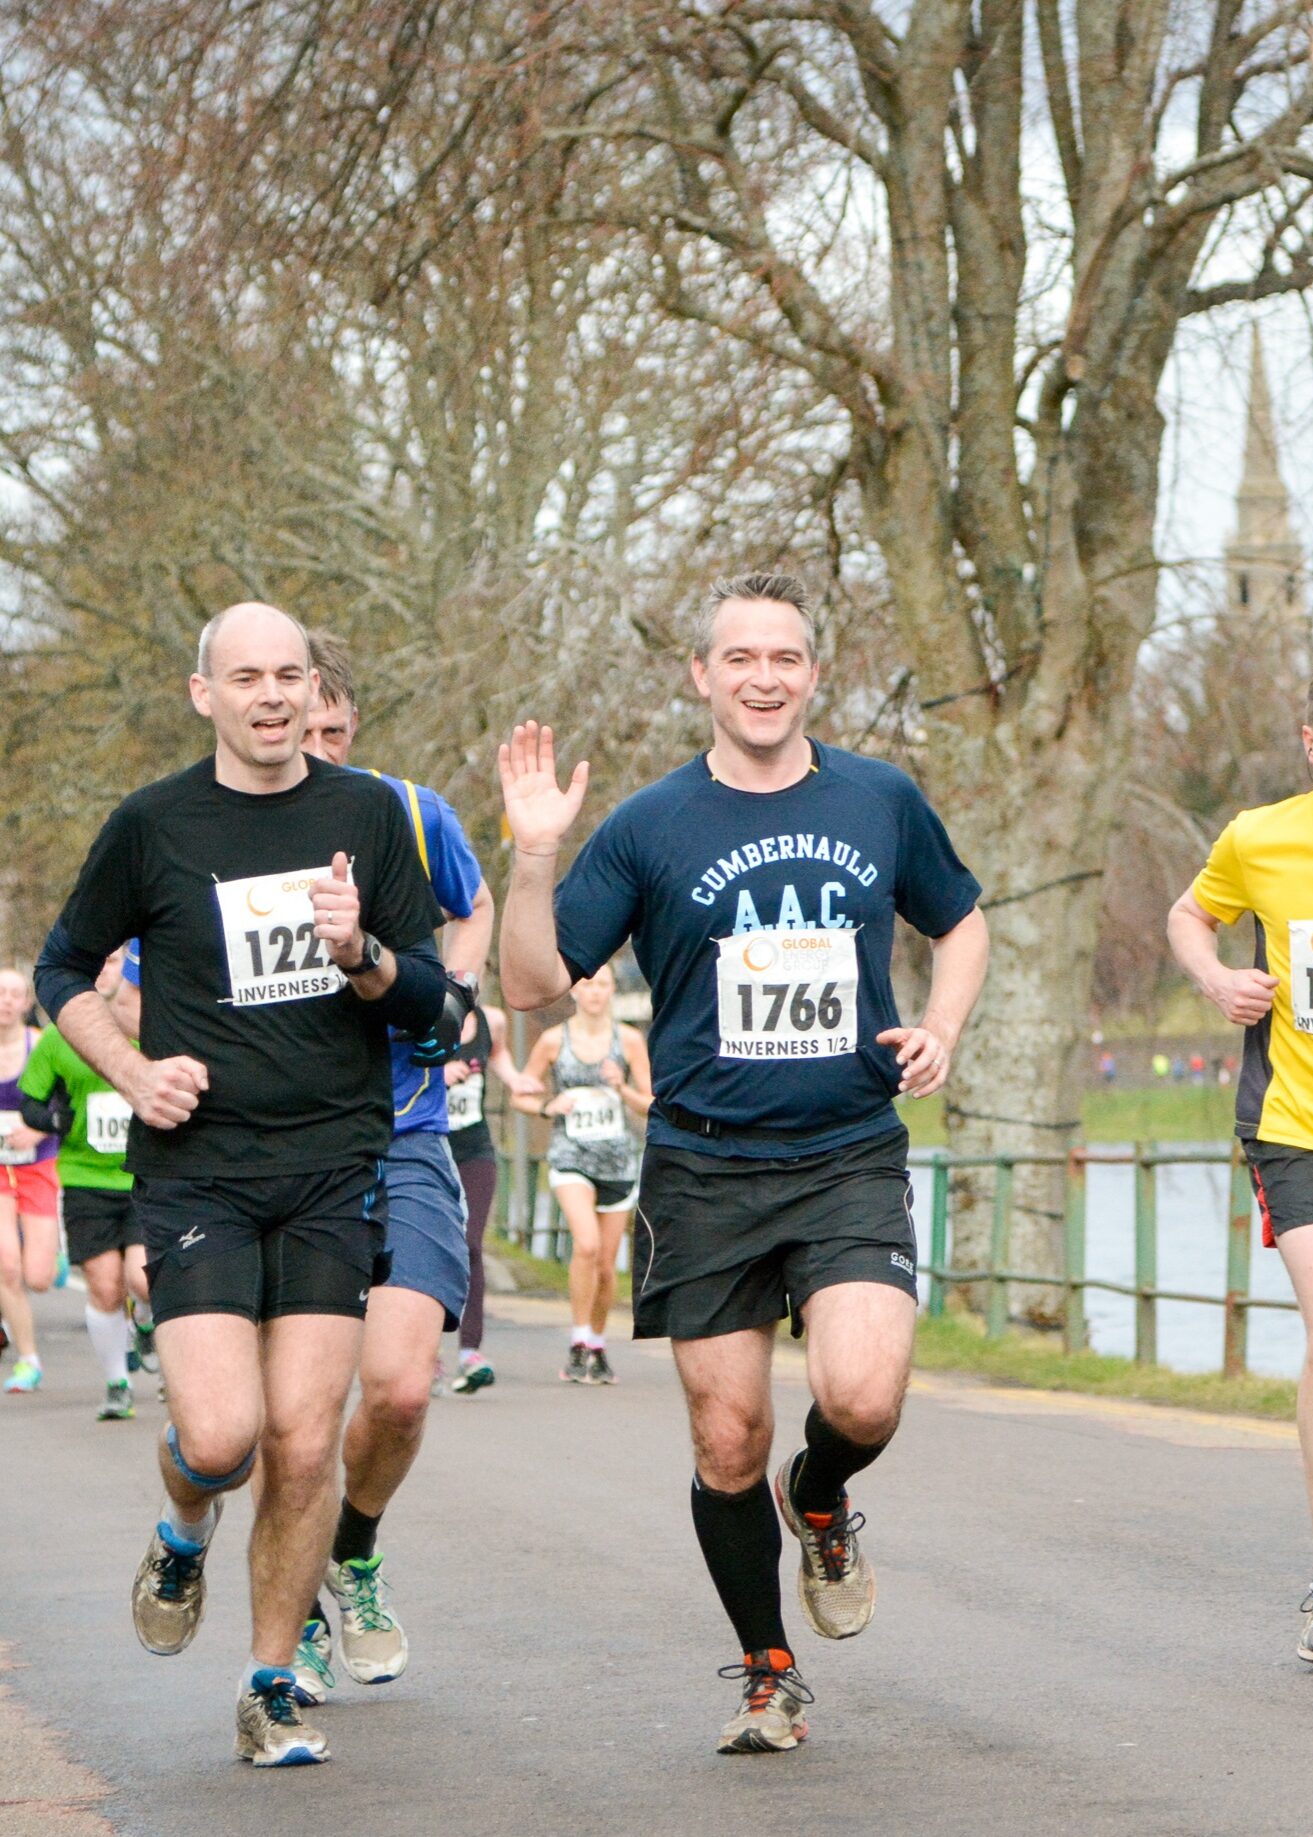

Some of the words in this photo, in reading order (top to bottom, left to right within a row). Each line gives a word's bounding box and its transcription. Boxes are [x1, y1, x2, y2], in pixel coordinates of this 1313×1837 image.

[691, 833, 878, 907] CUMBERNAULD
[244, 922, 338, 977] 122
[782, 938, 833, 950] GLOBAL
[238, 976, 329, 1003] INVERNESS
[737, 981, 842, 1033] 1766
[726, 1038, 819, 1056] INVERNESS
[827, 1036, 849, 1055] 1/2
[96, 1116, 130, 1138] 109
